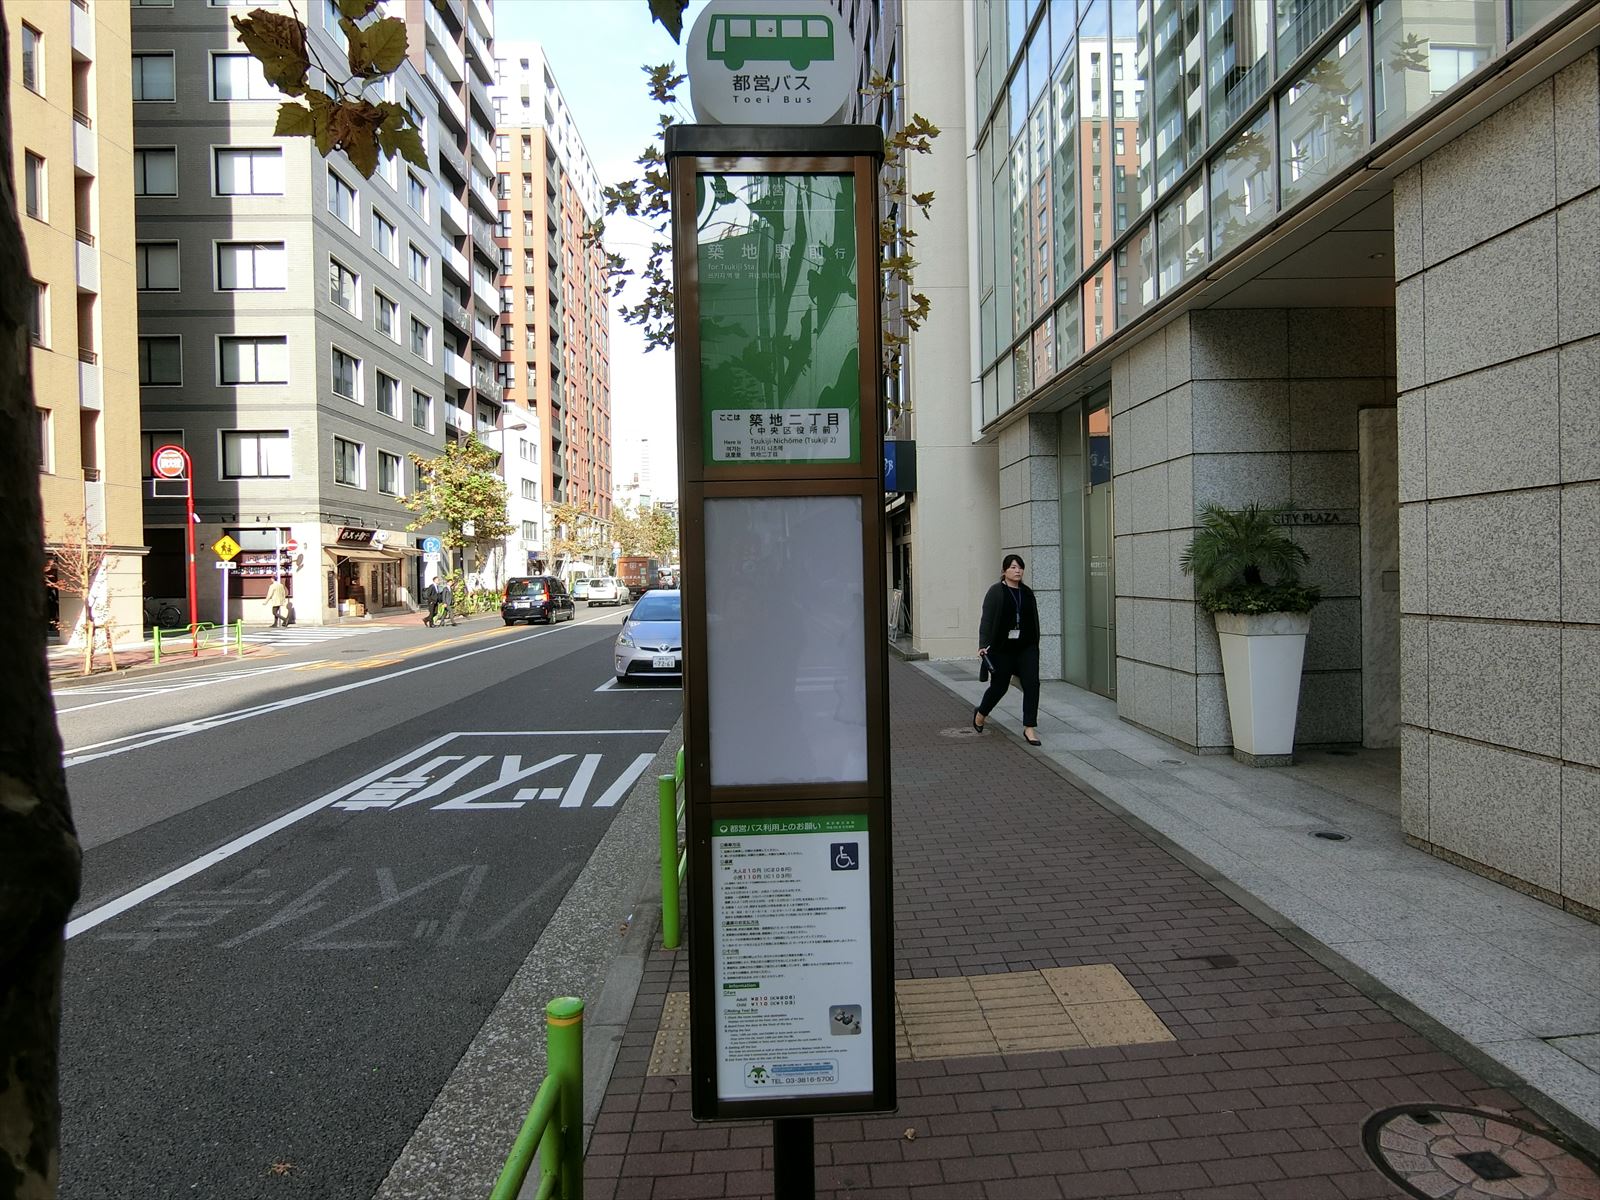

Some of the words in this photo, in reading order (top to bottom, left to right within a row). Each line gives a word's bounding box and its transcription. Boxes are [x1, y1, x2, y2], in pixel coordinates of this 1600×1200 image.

[732, 74, 811, 92] 都営バス
[733, 95, 770, 104] Toei
[783, 95, 812, 104] Bus
[749, 412, 839, 427] 築地二丁目
[1272, 513, 1298, 524] CITY
[1303, 512, 1340, 523] PLAZA
[729, 822, 822, 833] 都営バス利用上のお願い
